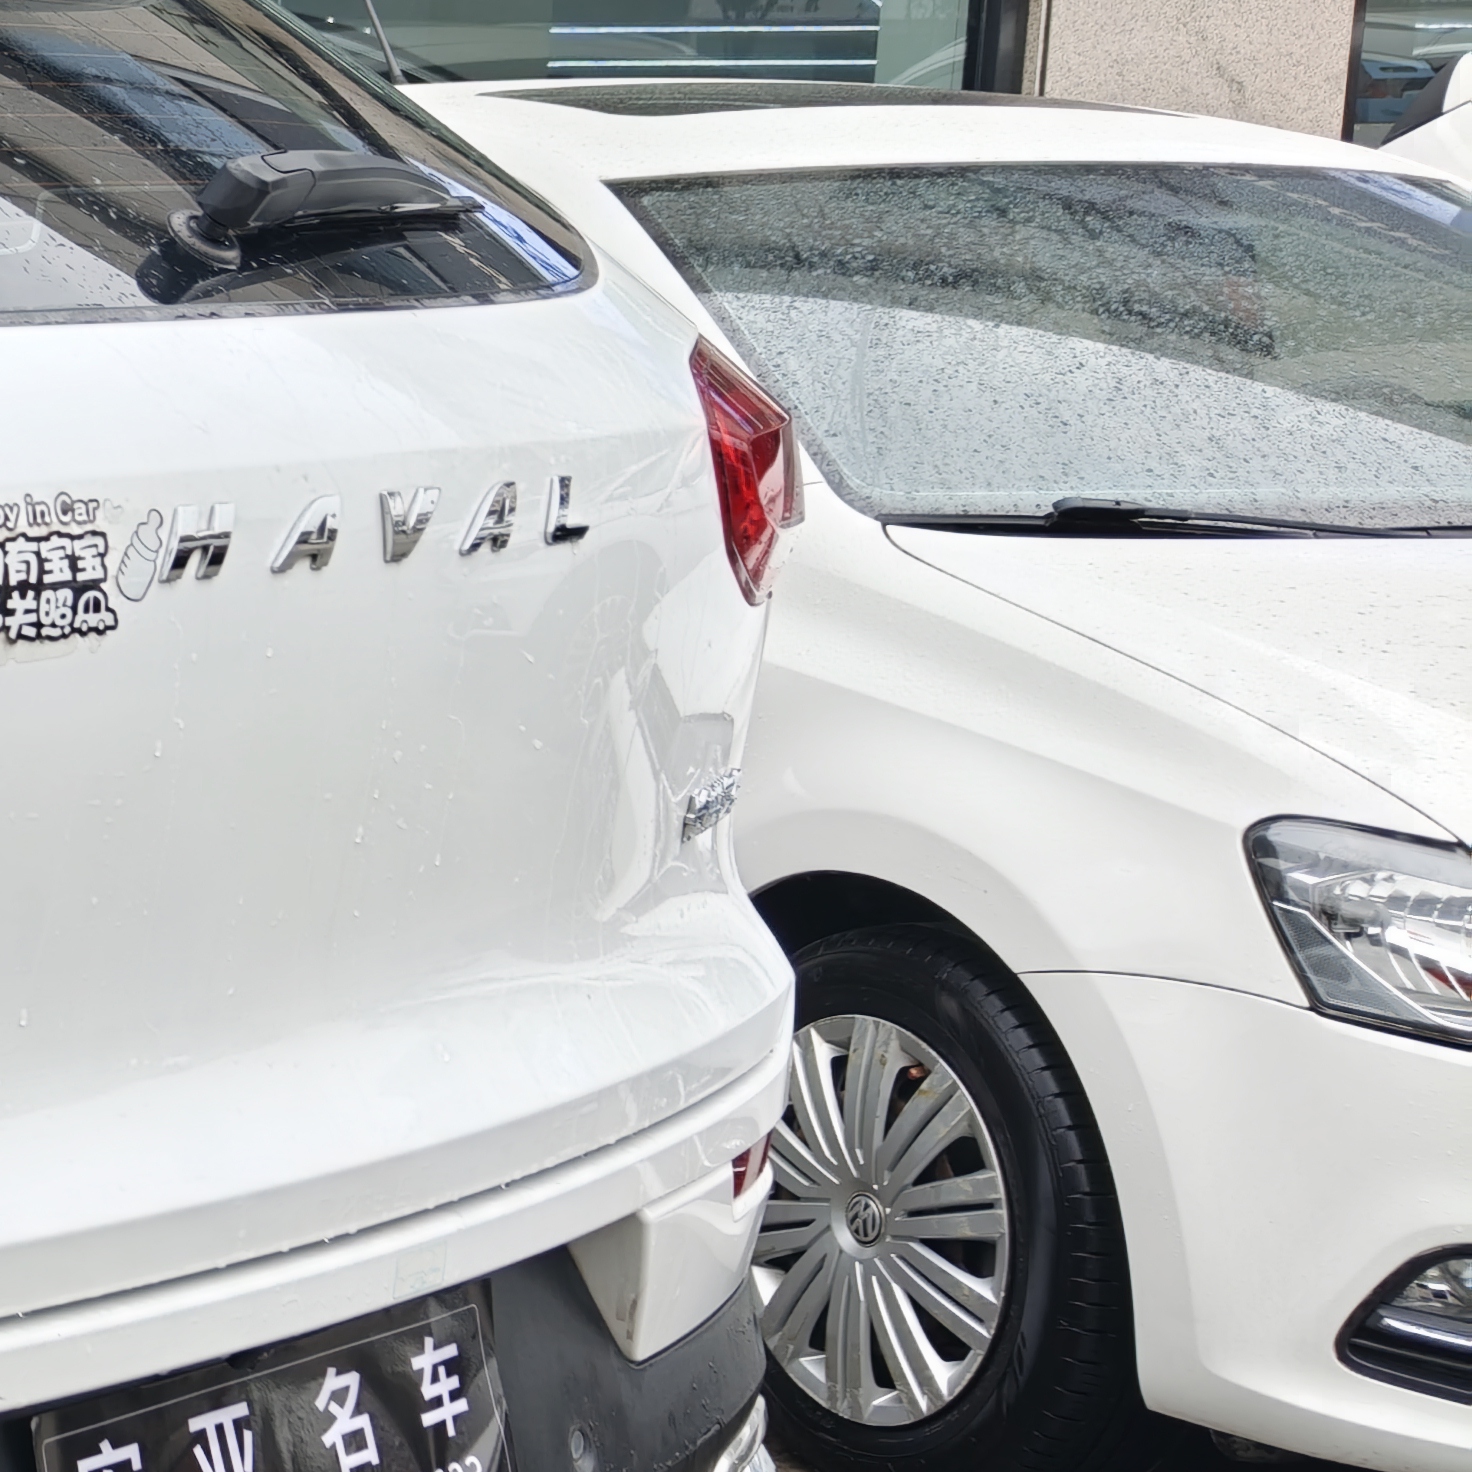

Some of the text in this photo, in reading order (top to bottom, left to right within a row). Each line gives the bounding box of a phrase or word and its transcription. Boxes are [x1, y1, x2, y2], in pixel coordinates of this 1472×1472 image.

[24, 494, 53, 527] in
[54, 492, 100, 526] Car
[157, 475, 590, 584] HAVAL
